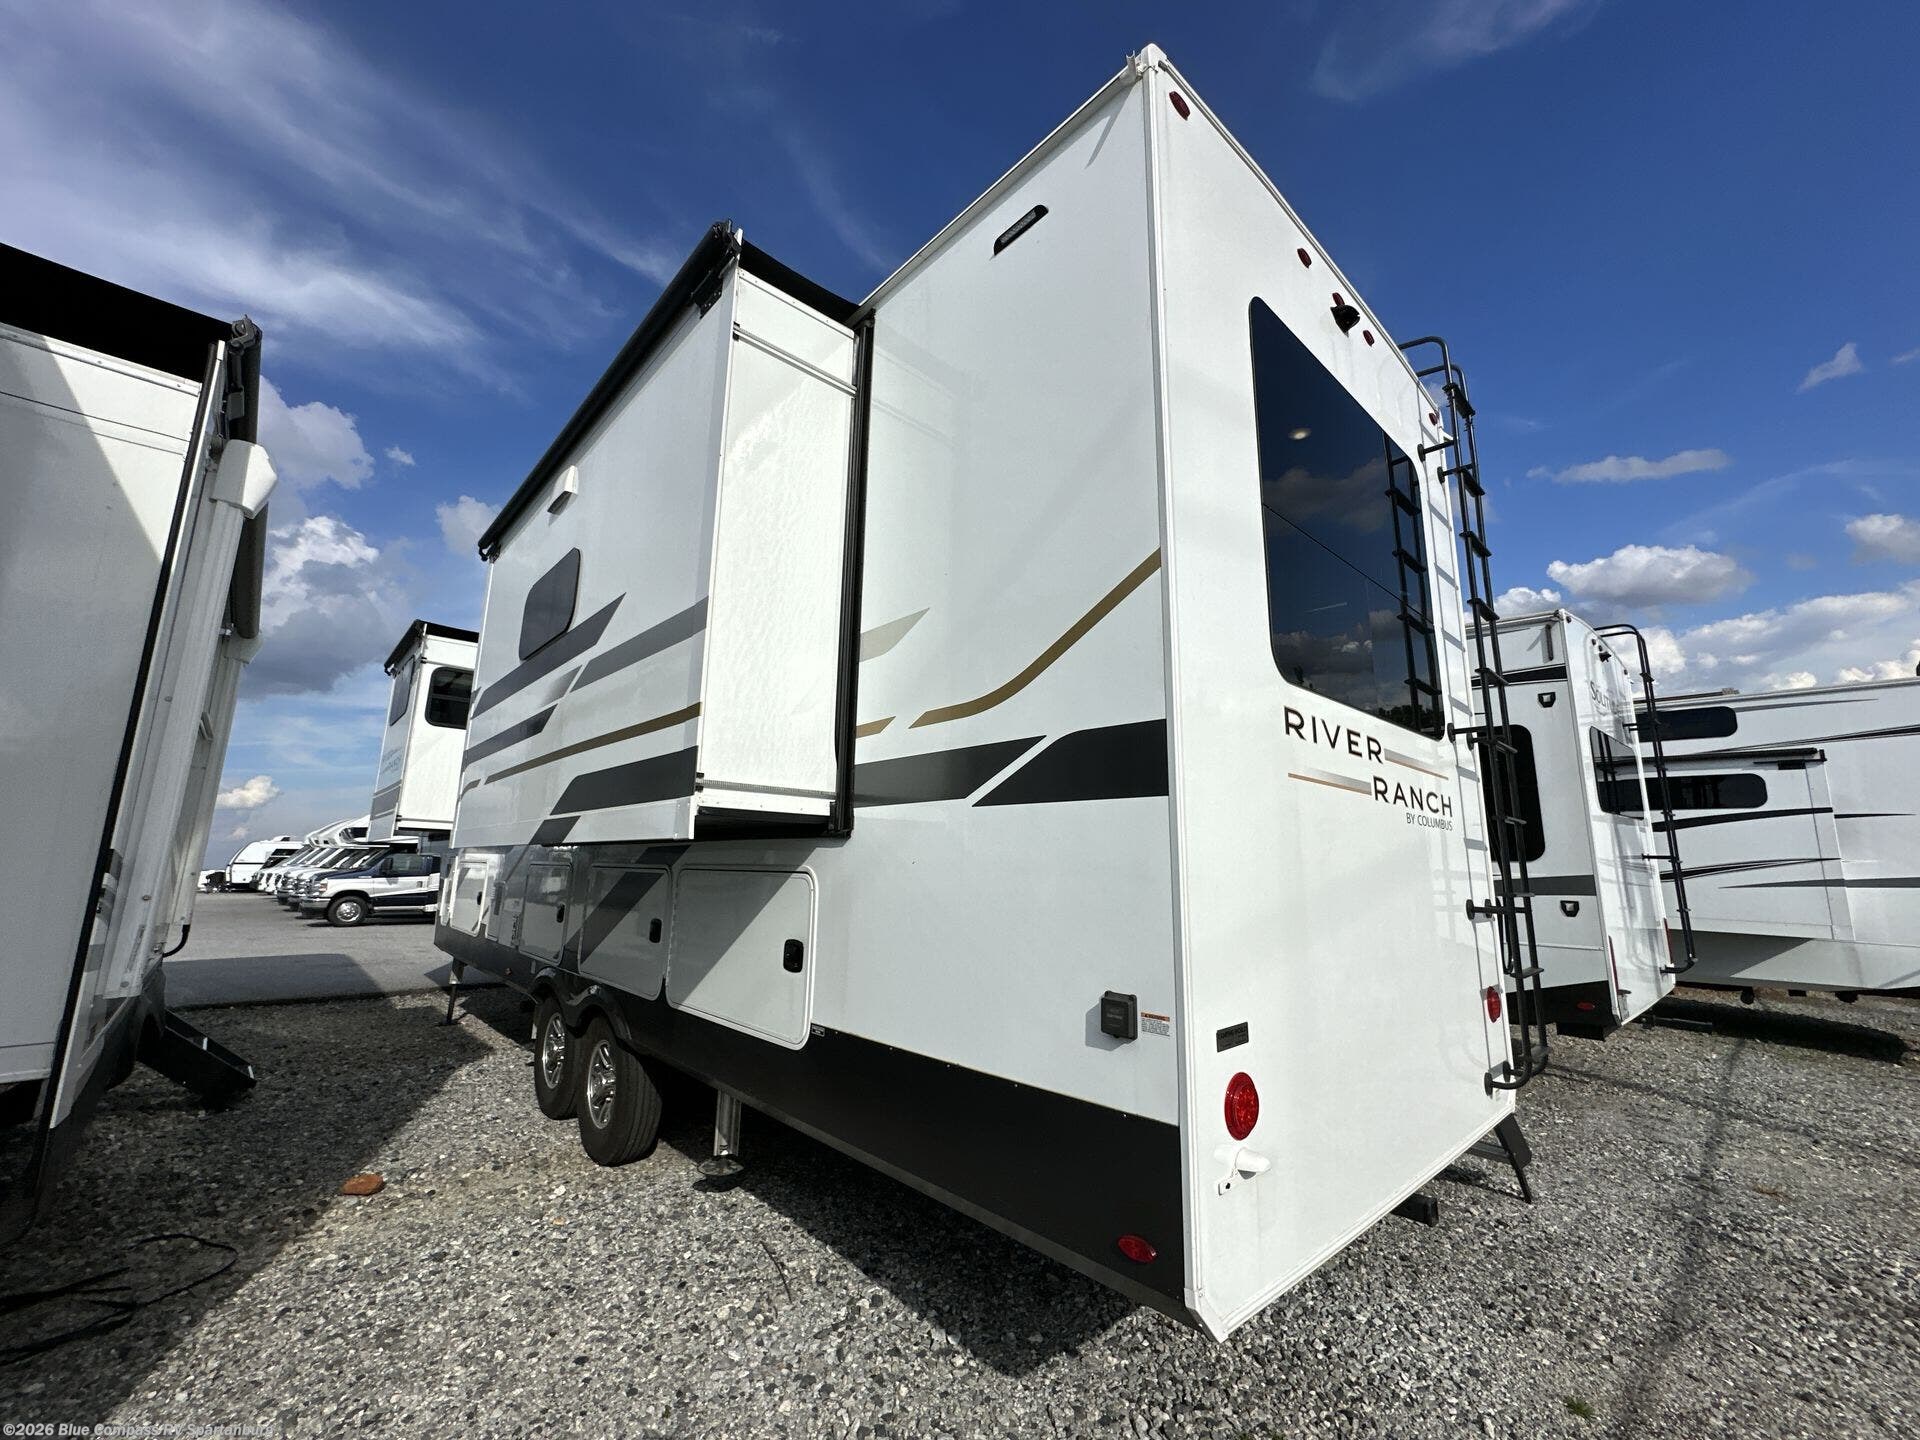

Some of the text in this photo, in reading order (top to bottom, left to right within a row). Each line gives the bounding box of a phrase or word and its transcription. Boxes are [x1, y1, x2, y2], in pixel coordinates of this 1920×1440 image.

[1283, 705, 1384, 764] RIVER
[1372, 775, 1453, 818] RANCH
[1406, 812, 1453, 832] BY COLUMBUS
